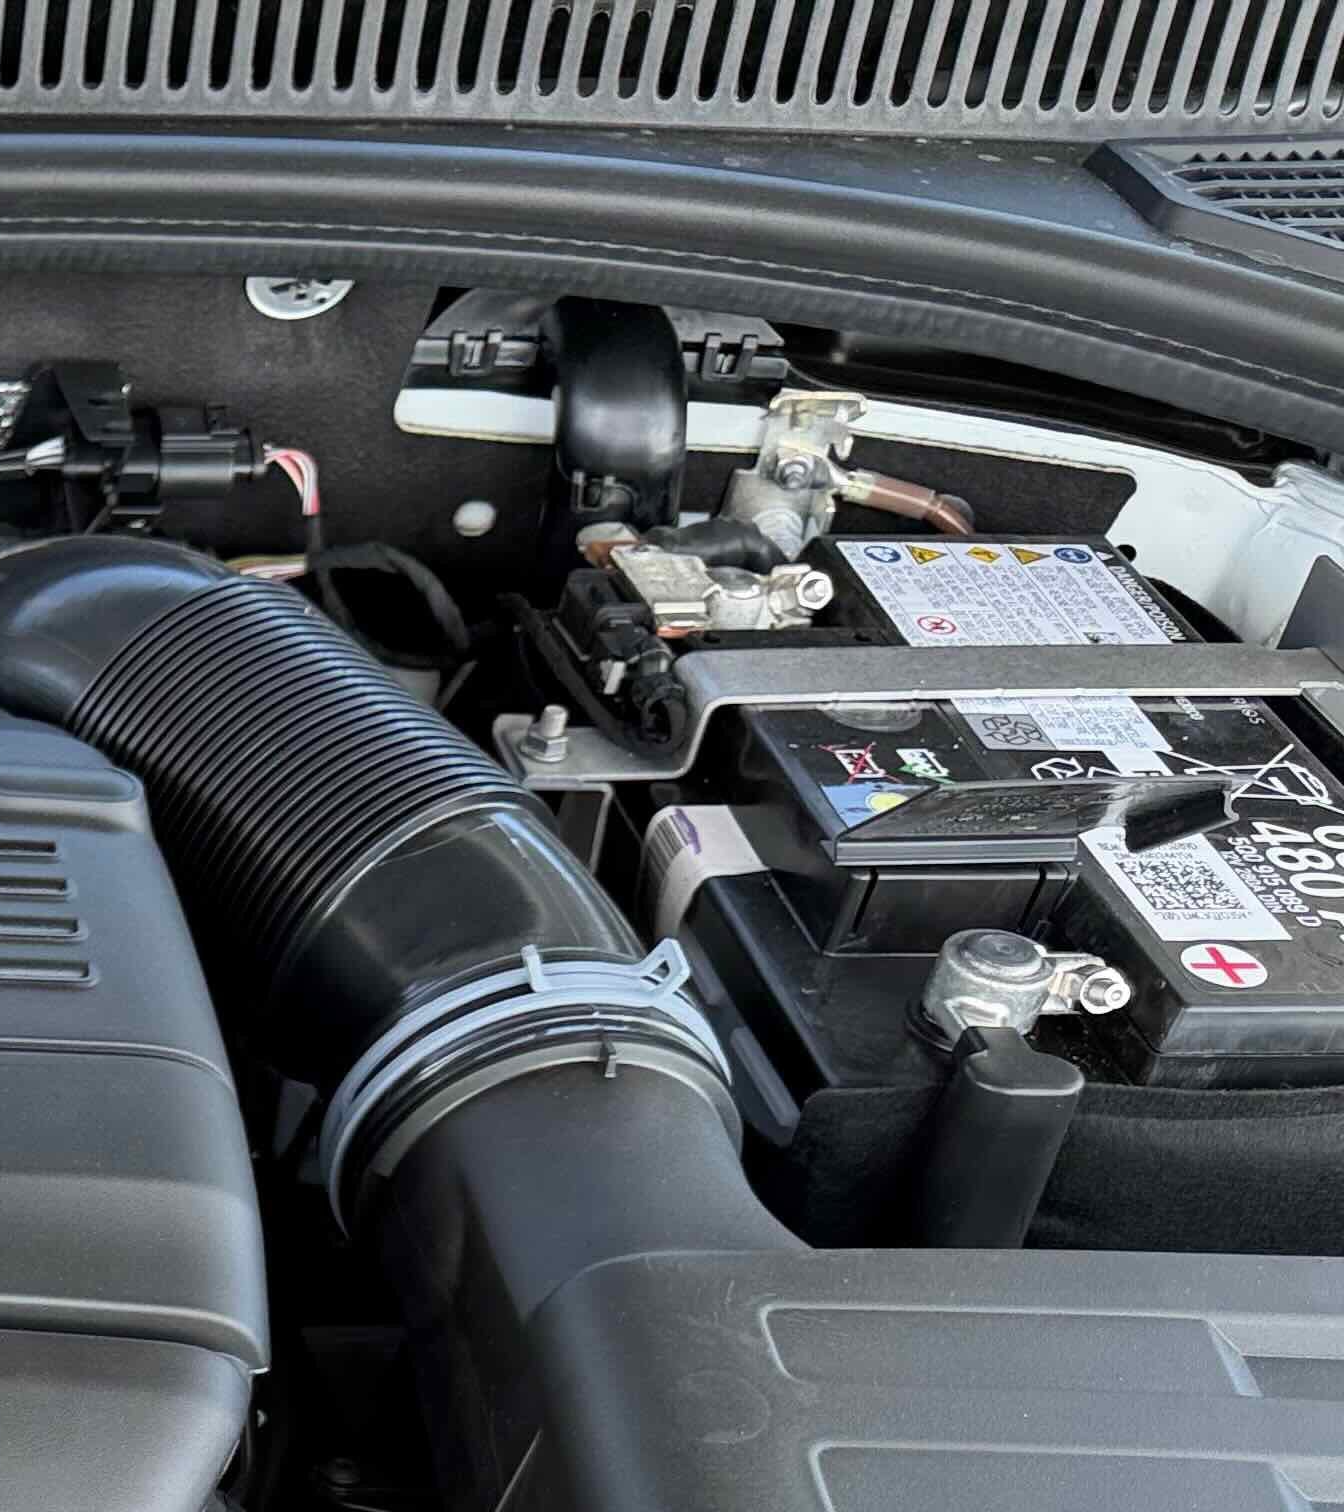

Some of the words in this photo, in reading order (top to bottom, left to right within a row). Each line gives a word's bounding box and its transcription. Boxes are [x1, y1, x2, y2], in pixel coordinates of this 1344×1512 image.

[1252, 865, 1287, 887] 915
[1273, 889, 1309, 913] 089
[1258, 894, 1287, 914] DIN
